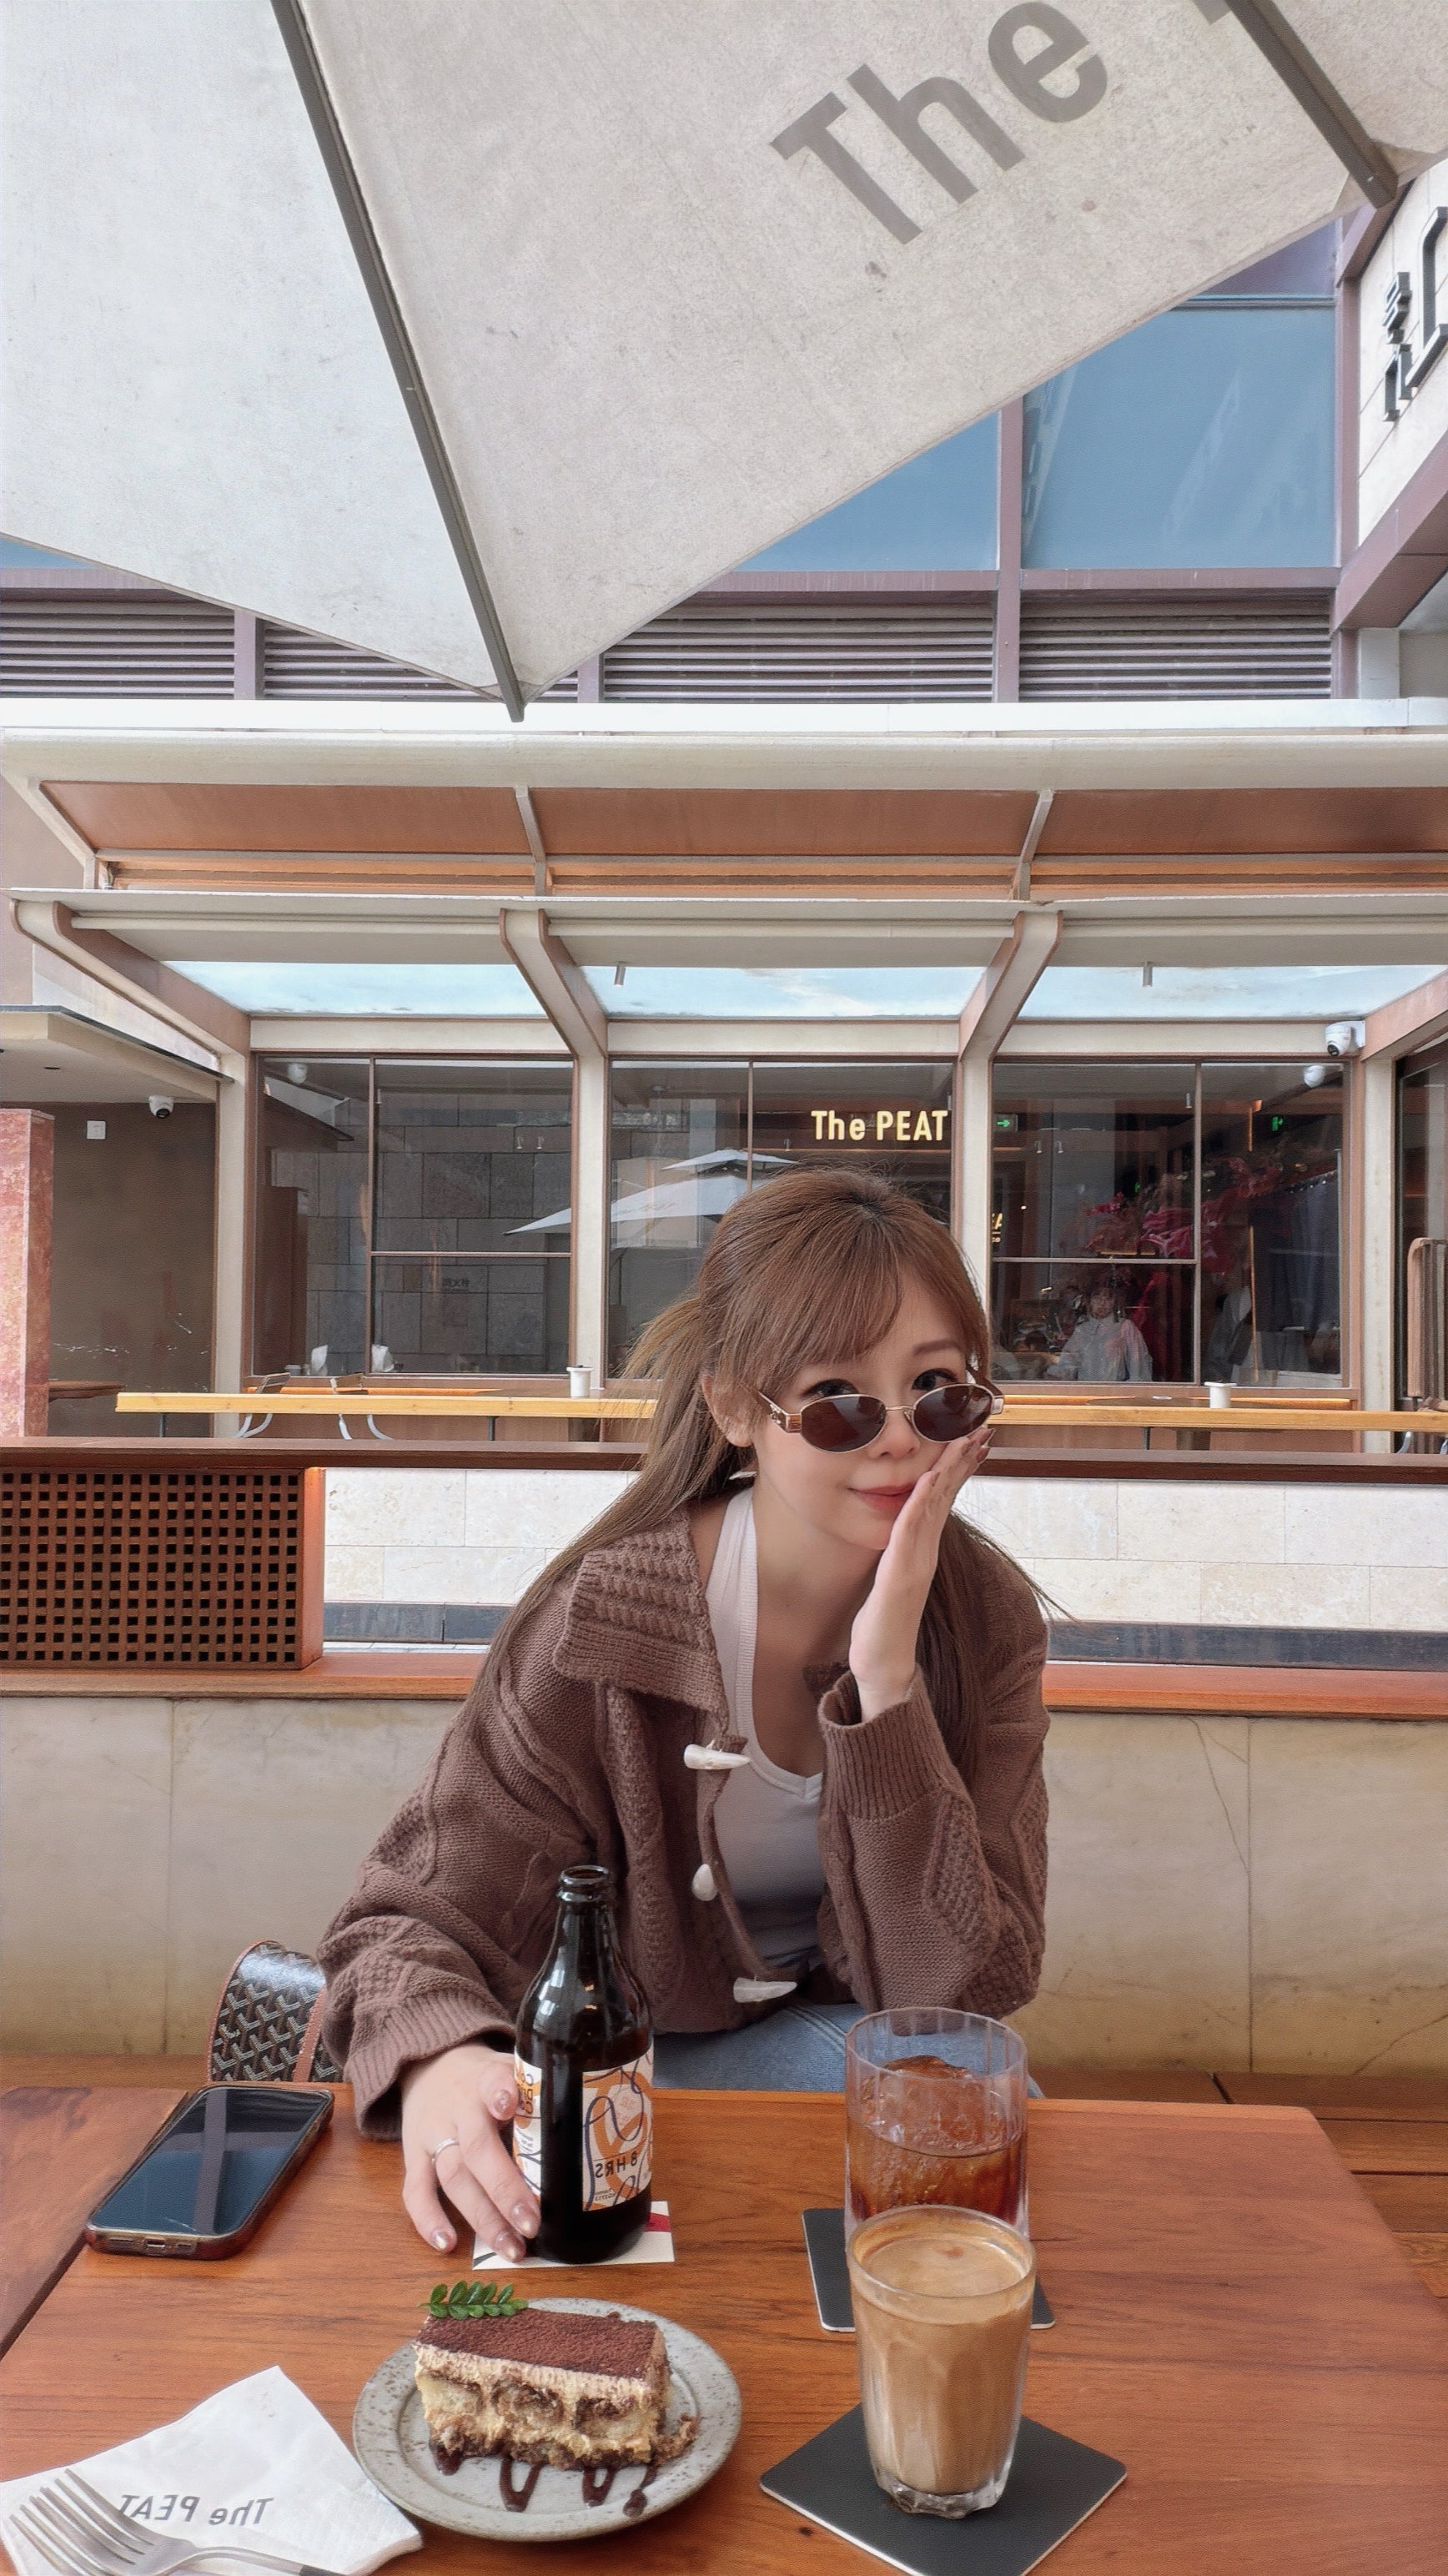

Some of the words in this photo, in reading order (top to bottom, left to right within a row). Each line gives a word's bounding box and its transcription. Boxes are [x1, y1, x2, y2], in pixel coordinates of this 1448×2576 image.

[770, 1, 1108, 245] The
[811, 1110, 866, 1141] The
[876, 1110, 948, 1141] PEAT
